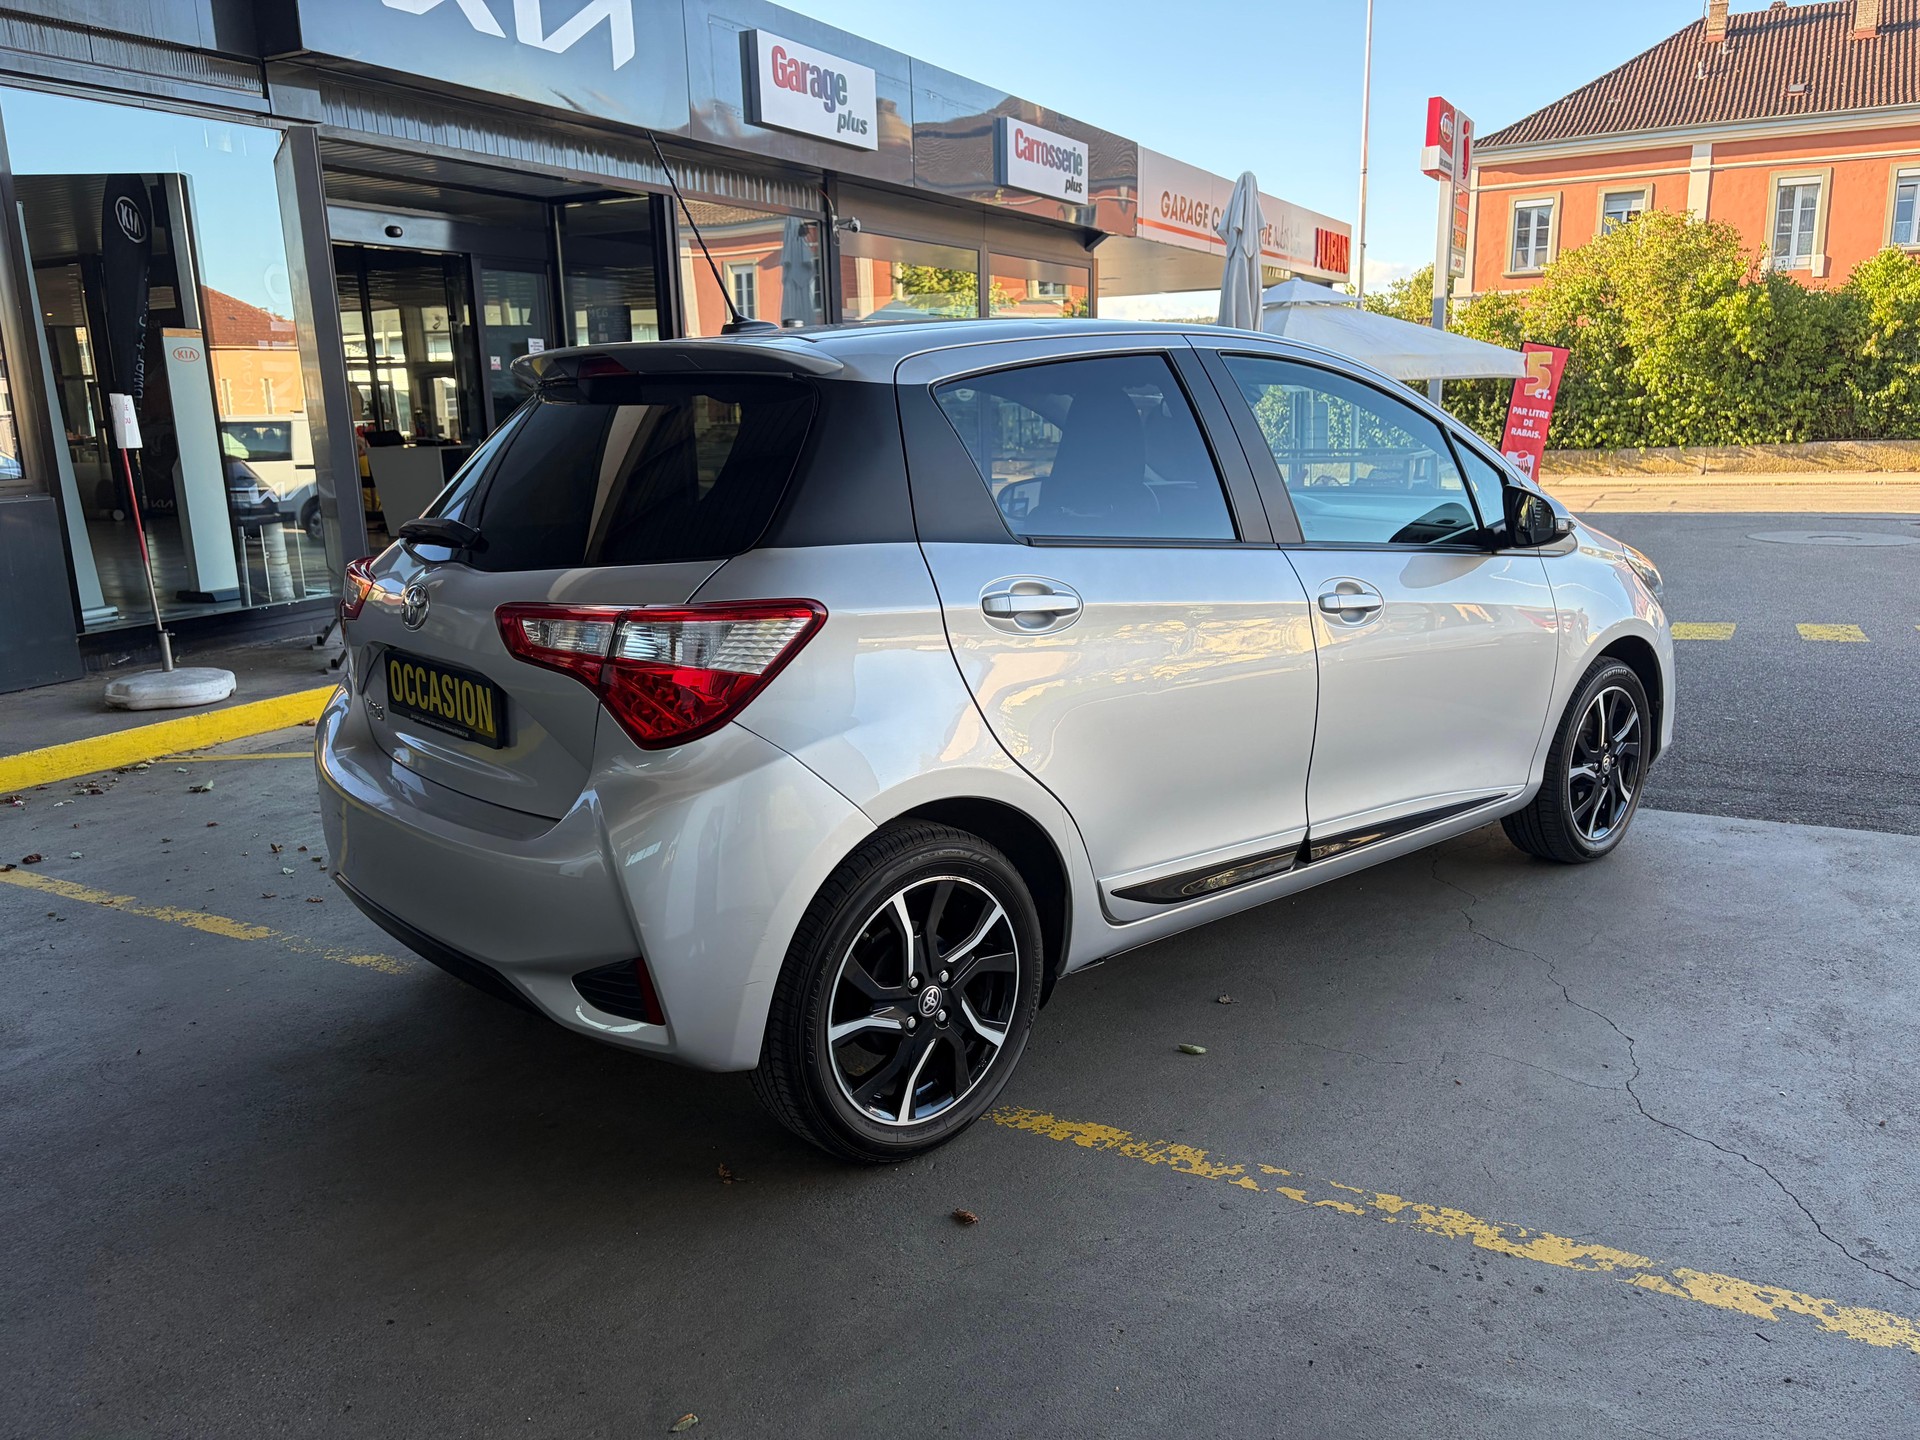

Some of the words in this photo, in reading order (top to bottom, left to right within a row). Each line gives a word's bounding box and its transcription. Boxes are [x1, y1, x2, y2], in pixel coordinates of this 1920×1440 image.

[771, 45, 848, 113] Garage
[836, 110, 868, 135] plus
[1015, 128, 1083, 177] Carrosserie
[1064, 176, 1083, 194] plus
[119, 202, 142, 237] KIA
[1161, 190, 1210, 230] GARAGE
[1314, 226, 1350, 275] JUBIN
[177, 351, 197, 360] KIA
[1524, 351, 1553, 396] 5
[1512, 406, 1527, 416] PAR
[1528, 408, 1550, 419] LITRE
[1523, 418, 1534, 428] DE
[1510, 427, 1541, 440] RABAIS.
[390, 660, 494, 733] OCCASION
